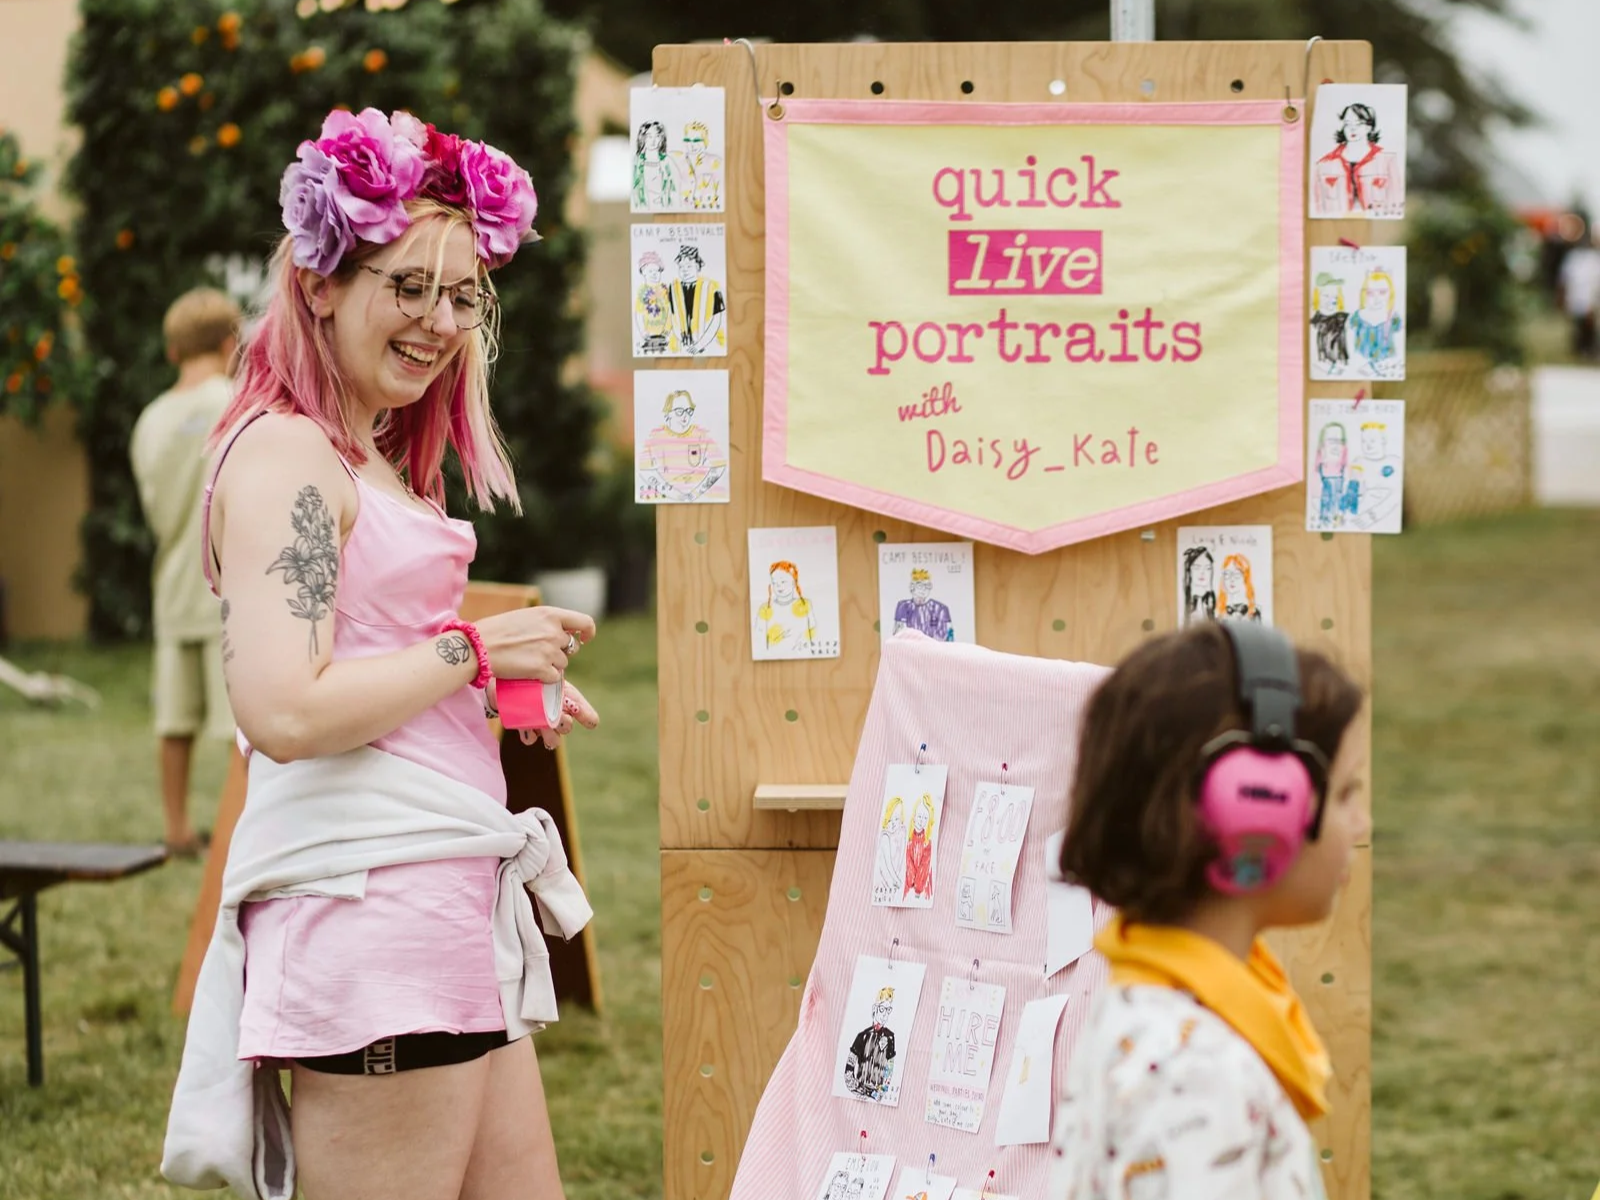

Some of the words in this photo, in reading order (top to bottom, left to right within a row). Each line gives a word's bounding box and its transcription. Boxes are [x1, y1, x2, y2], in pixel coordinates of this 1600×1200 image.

[932, 155, 1122, 221] quick
[953, 233, 1099, 289] live
[867, 307, 1203, 375] portraits
[898, 381, 962, 421] with
[926, 426, 1159, 480] Daisy_Kate
[881, 551, 906, 564] CAMP
[937, 1005, 1000, 1047] HIRE
[943, 1041, 979, 1076] ME
